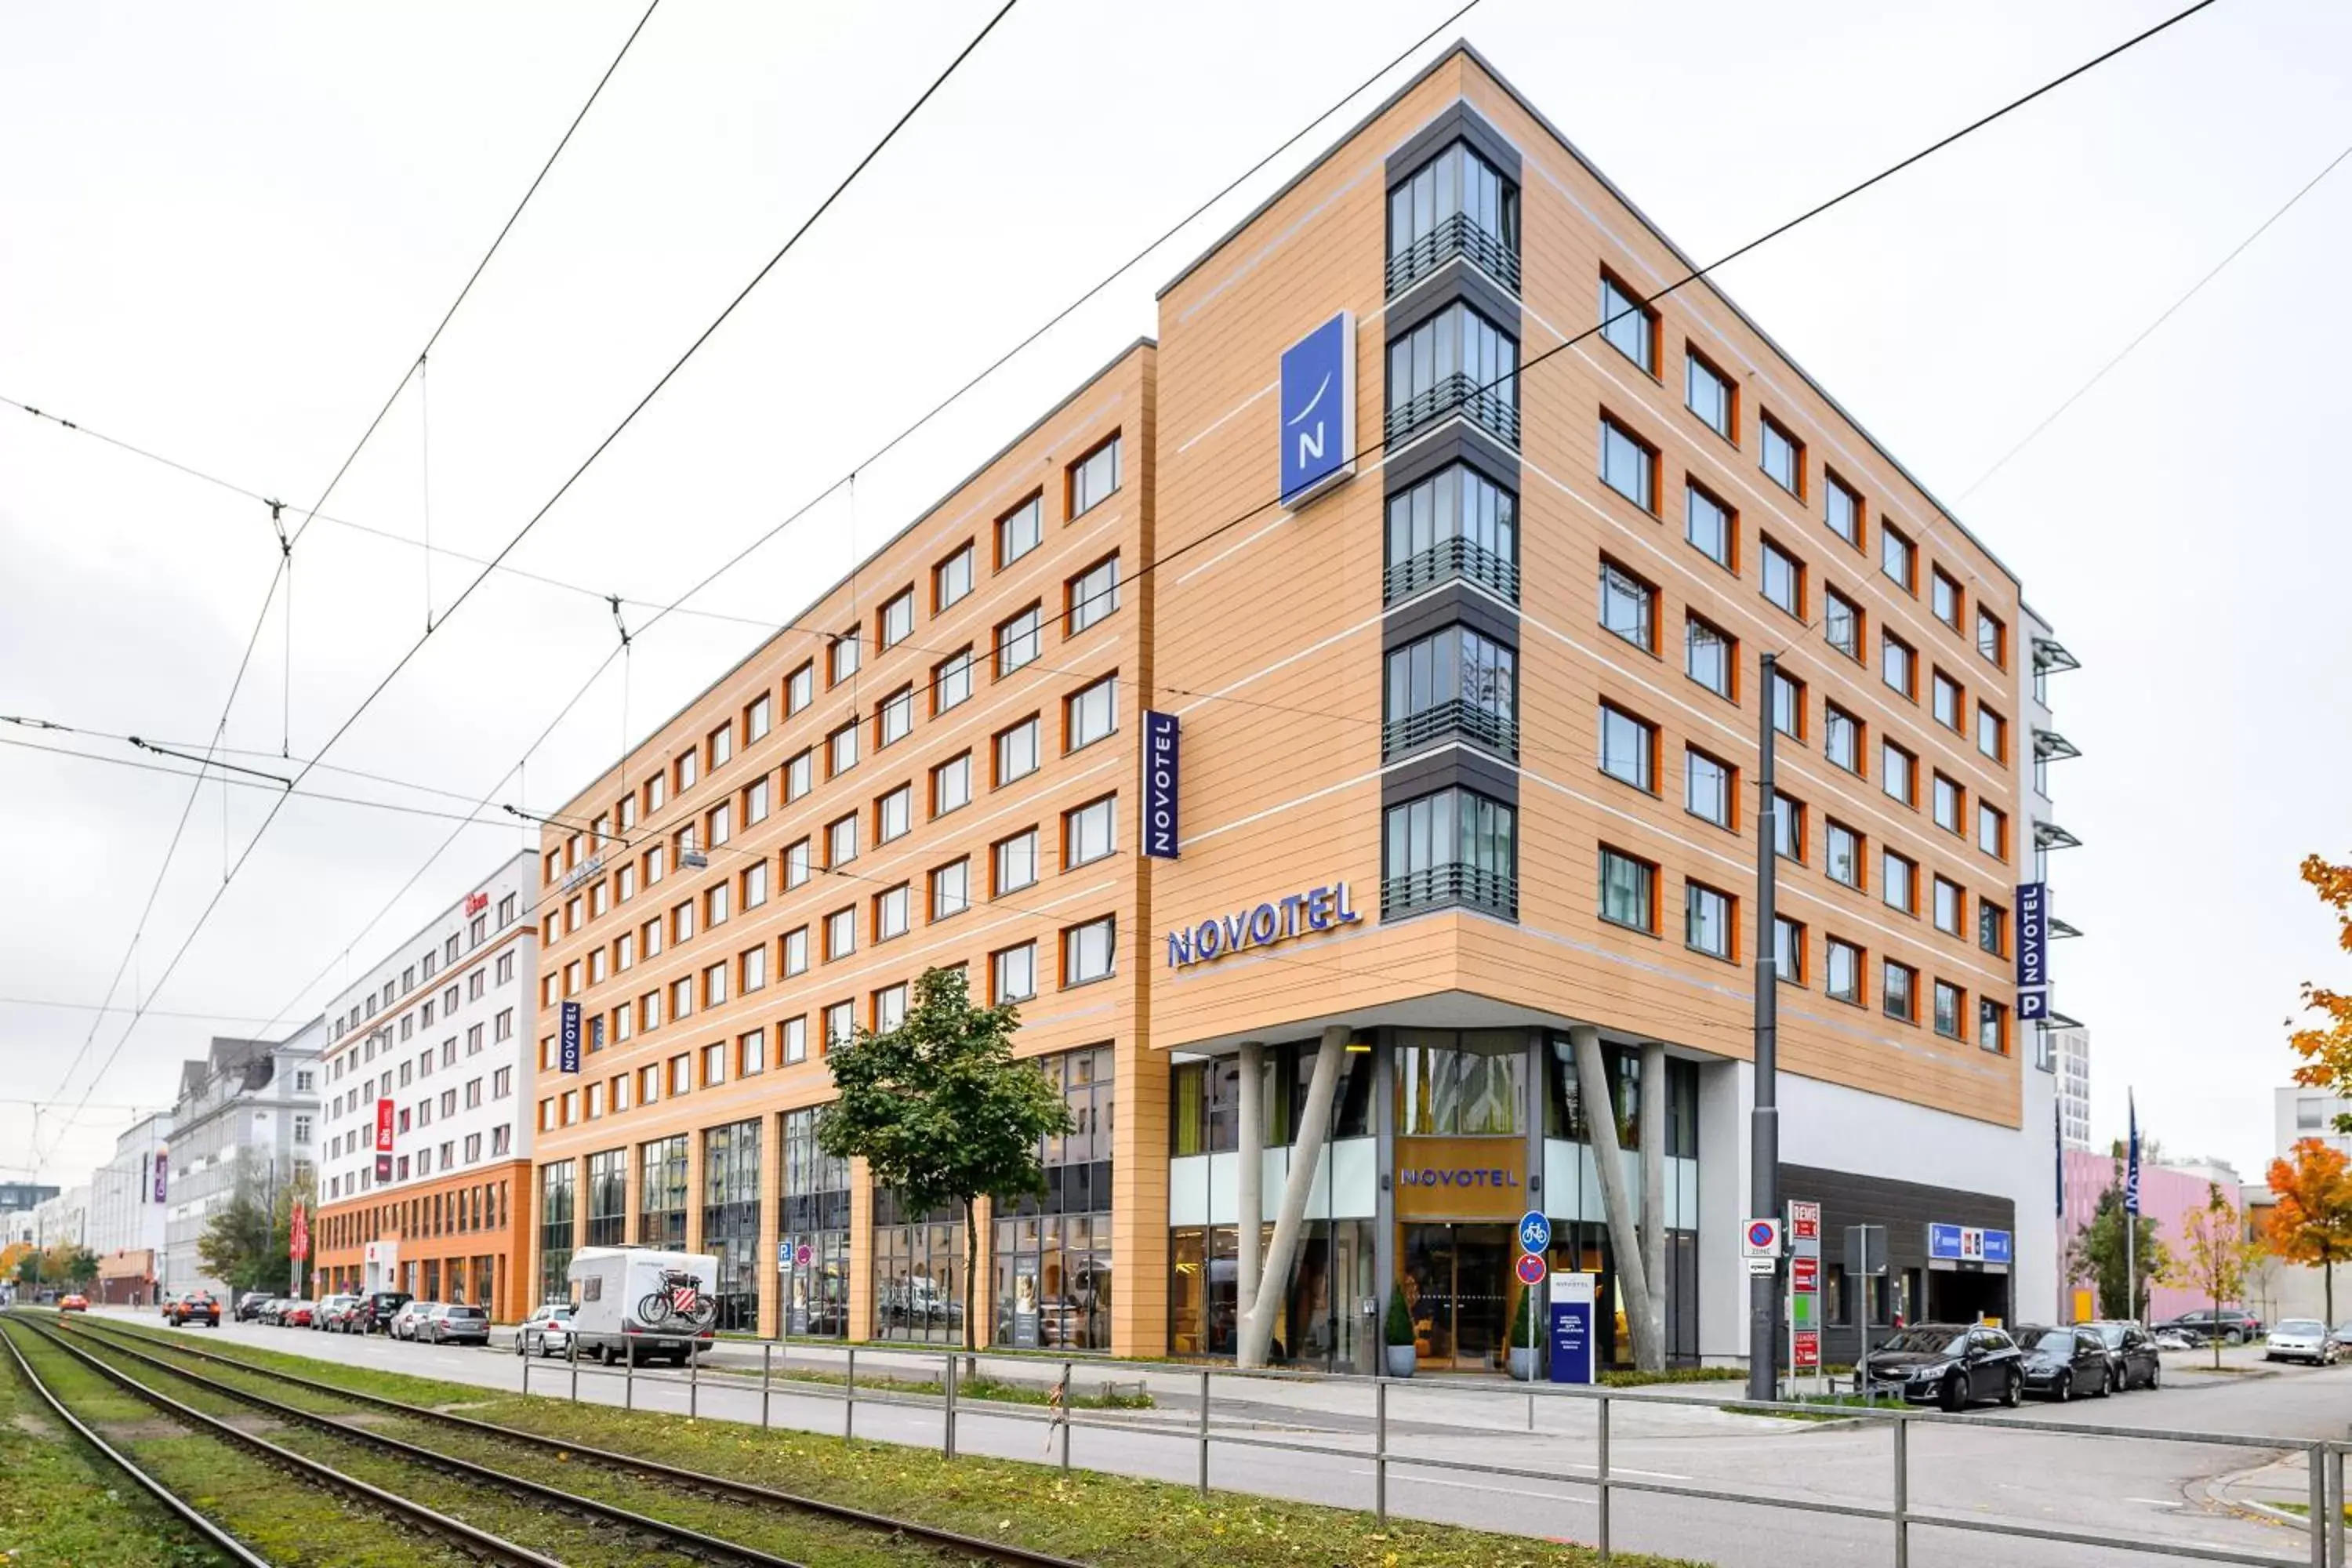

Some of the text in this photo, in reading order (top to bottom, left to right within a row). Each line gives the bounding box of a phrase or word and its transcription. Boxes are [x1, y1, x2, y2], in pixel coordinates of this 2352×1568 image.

[1299, 420, 1324, 470] N
[1155, 720, 1171, 851] NOVOTEL
[1167, 880, 1363, 969] NOVOTEL
[2024, 887, 2038, 982] NOVOTEL
[2023, 995, 2041, 1016] P
[565, 1005, 576, 1070] NOVOTEL
[1401, 1168, 1519, 1187] NOVOTEL
[780, 1244, 788, 1260] P
